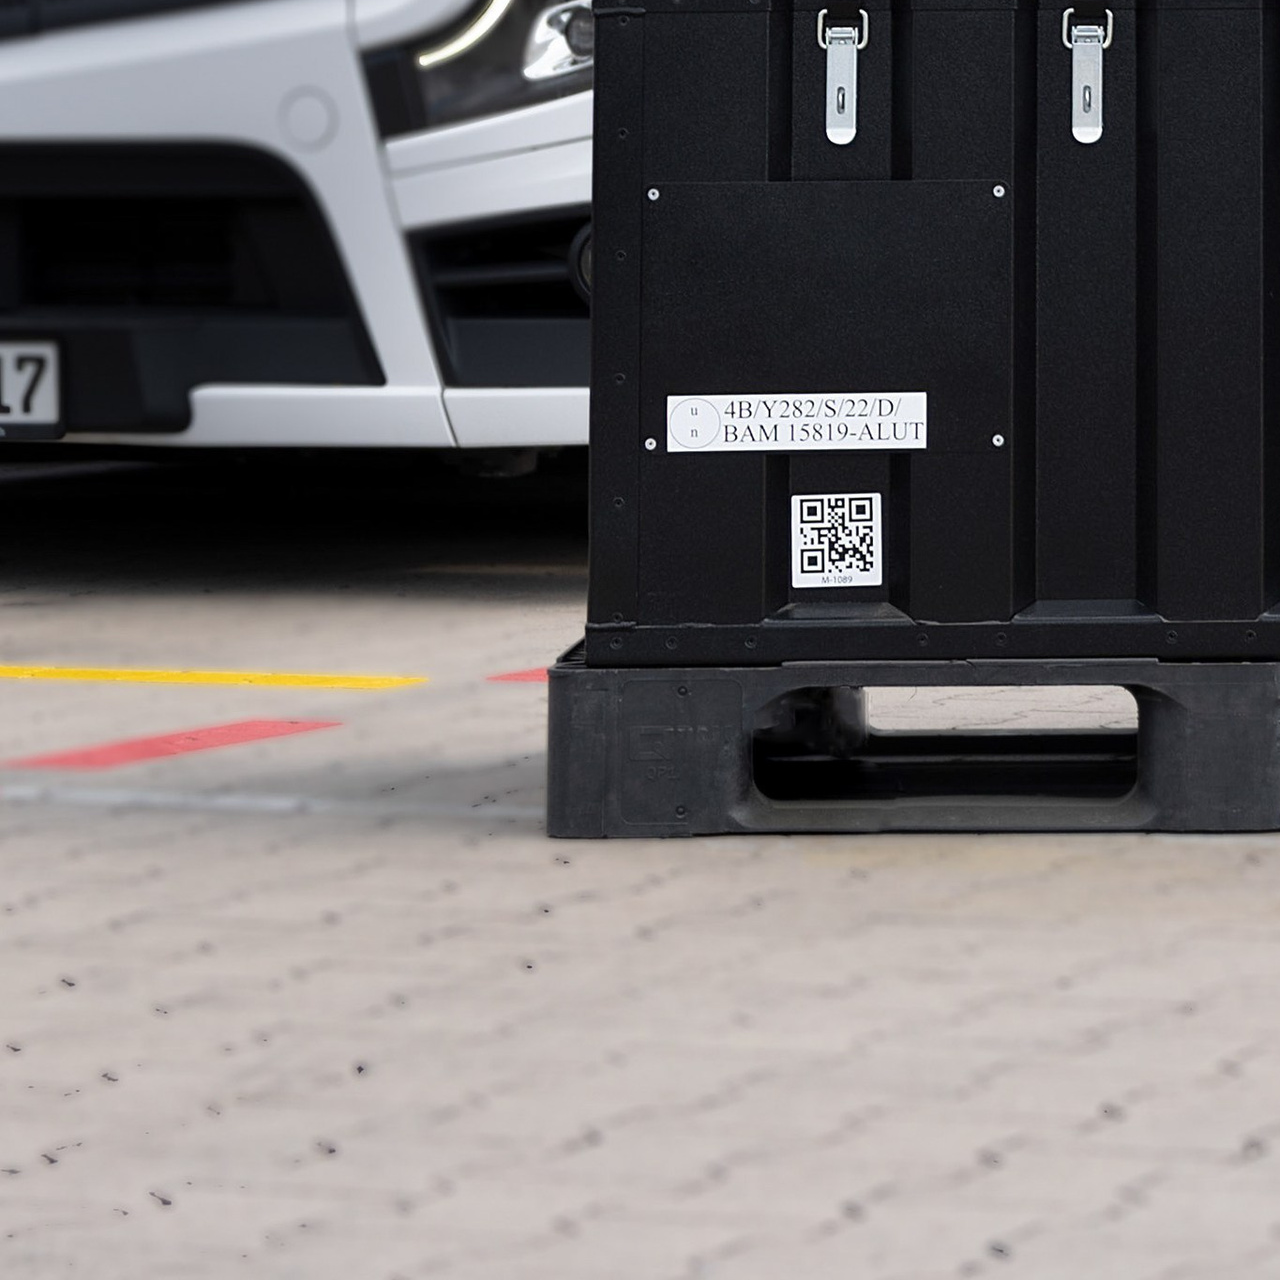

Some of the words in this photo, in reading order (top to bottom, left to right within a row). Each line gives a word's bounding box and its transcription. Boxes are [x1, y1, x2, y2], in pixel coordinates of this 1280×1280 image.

[724, 398, 902, 419] 4B/Y282/S/22/D/
[724, 423, 779, 443] BAM
[789, 421, 925, 442] 15819-ALUT
[821, 575, 853, 584] M-1089
